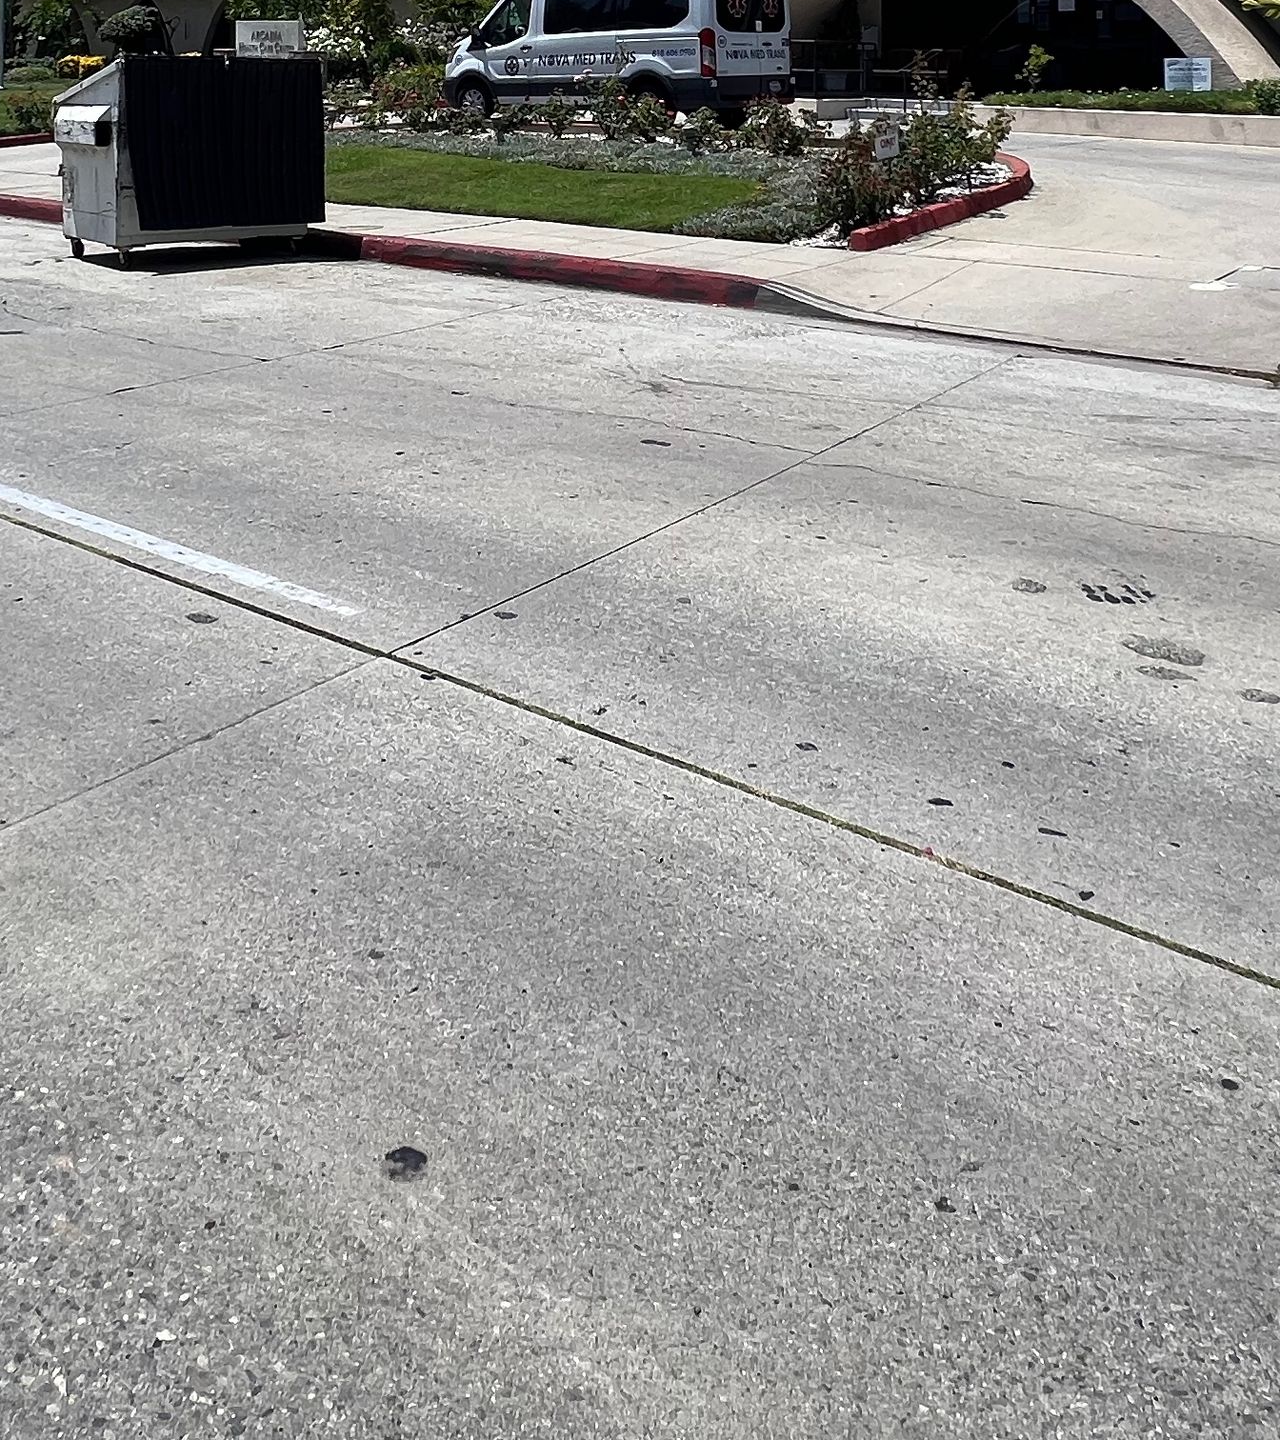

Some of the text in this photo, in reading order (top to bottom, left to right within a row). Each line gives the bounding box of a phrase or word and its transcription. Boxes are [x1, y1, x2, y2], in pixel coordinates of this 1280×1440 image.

[538, 51, 637, 67] NOVA MED TRANS
[725, 49, 749, 60] NOVA
[750, 49, 766, 59] MED
